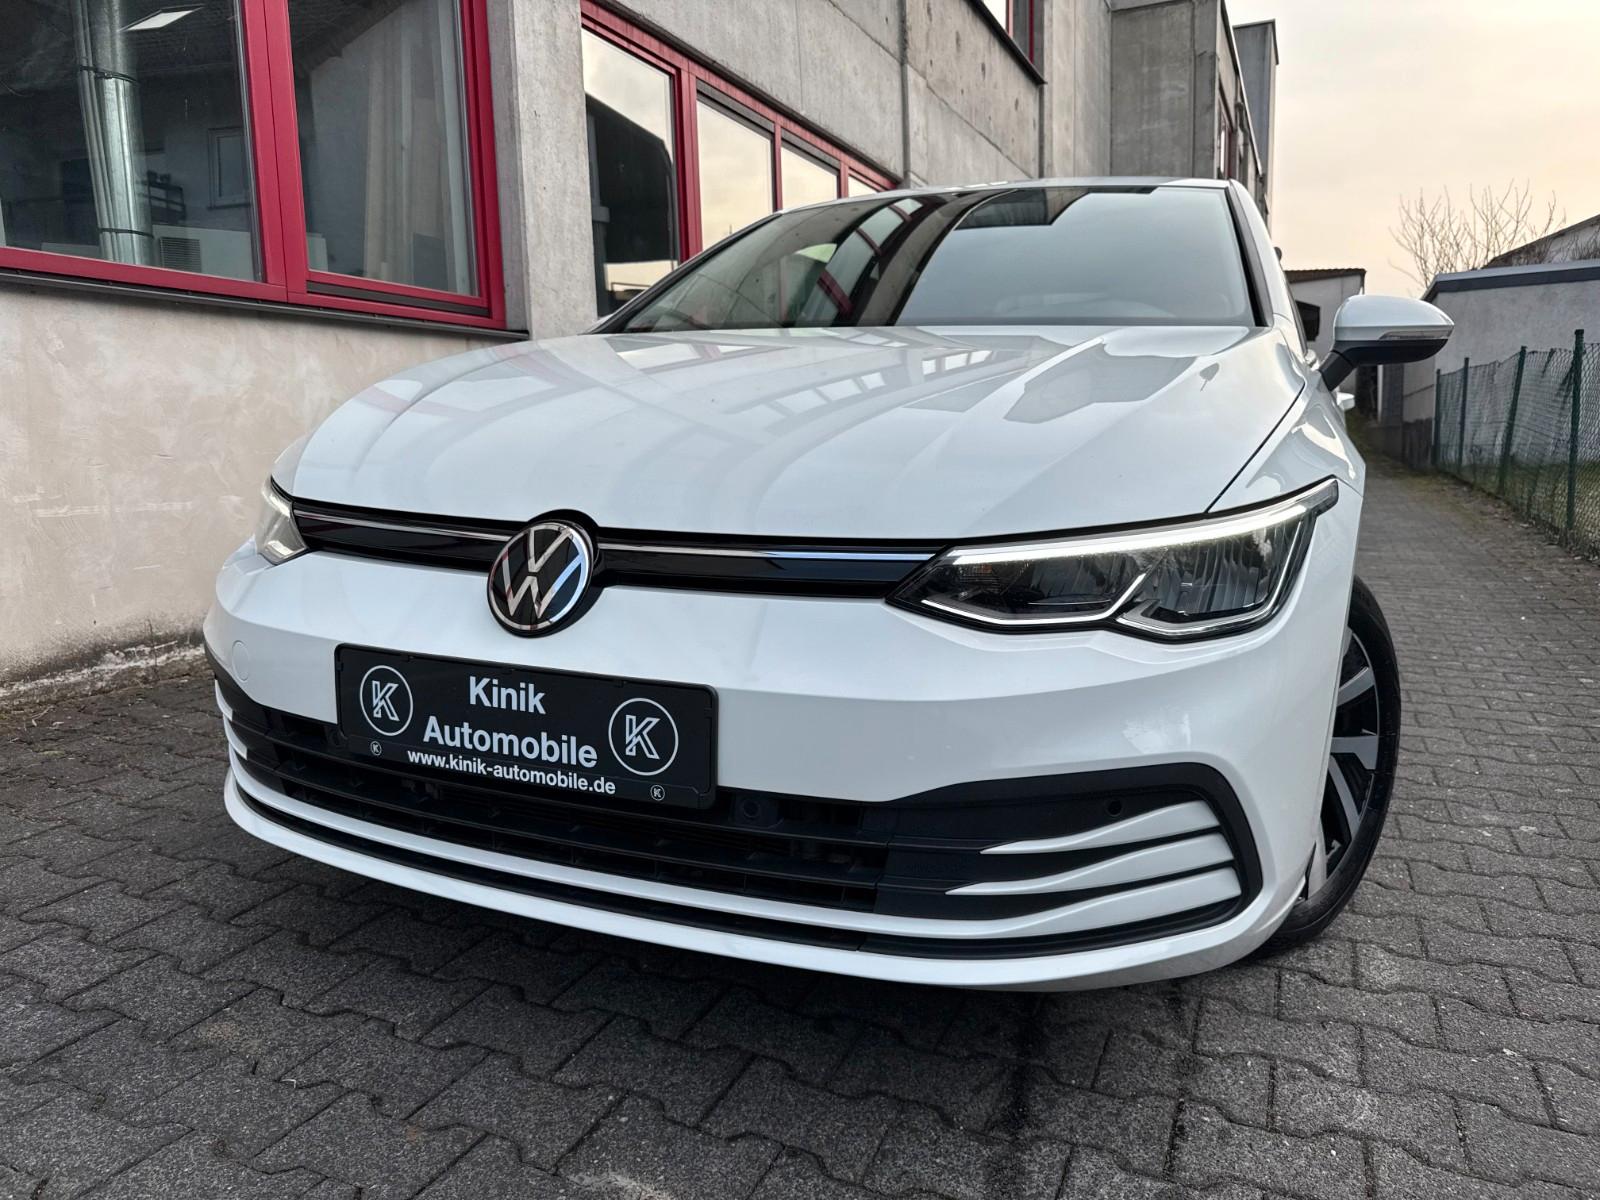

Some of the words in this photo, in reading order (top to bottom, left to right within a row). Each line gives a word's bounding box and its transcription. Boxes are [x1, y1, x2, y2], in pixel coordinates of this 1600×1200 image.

[372, 680, 399, 721] K
[469, 676, 546, 714] Kinik
[423, 716, 597, 768] Automobile
[625, 714, 660, 760] K
[407, 750, 615, 794] www.kinik-automobile.de
